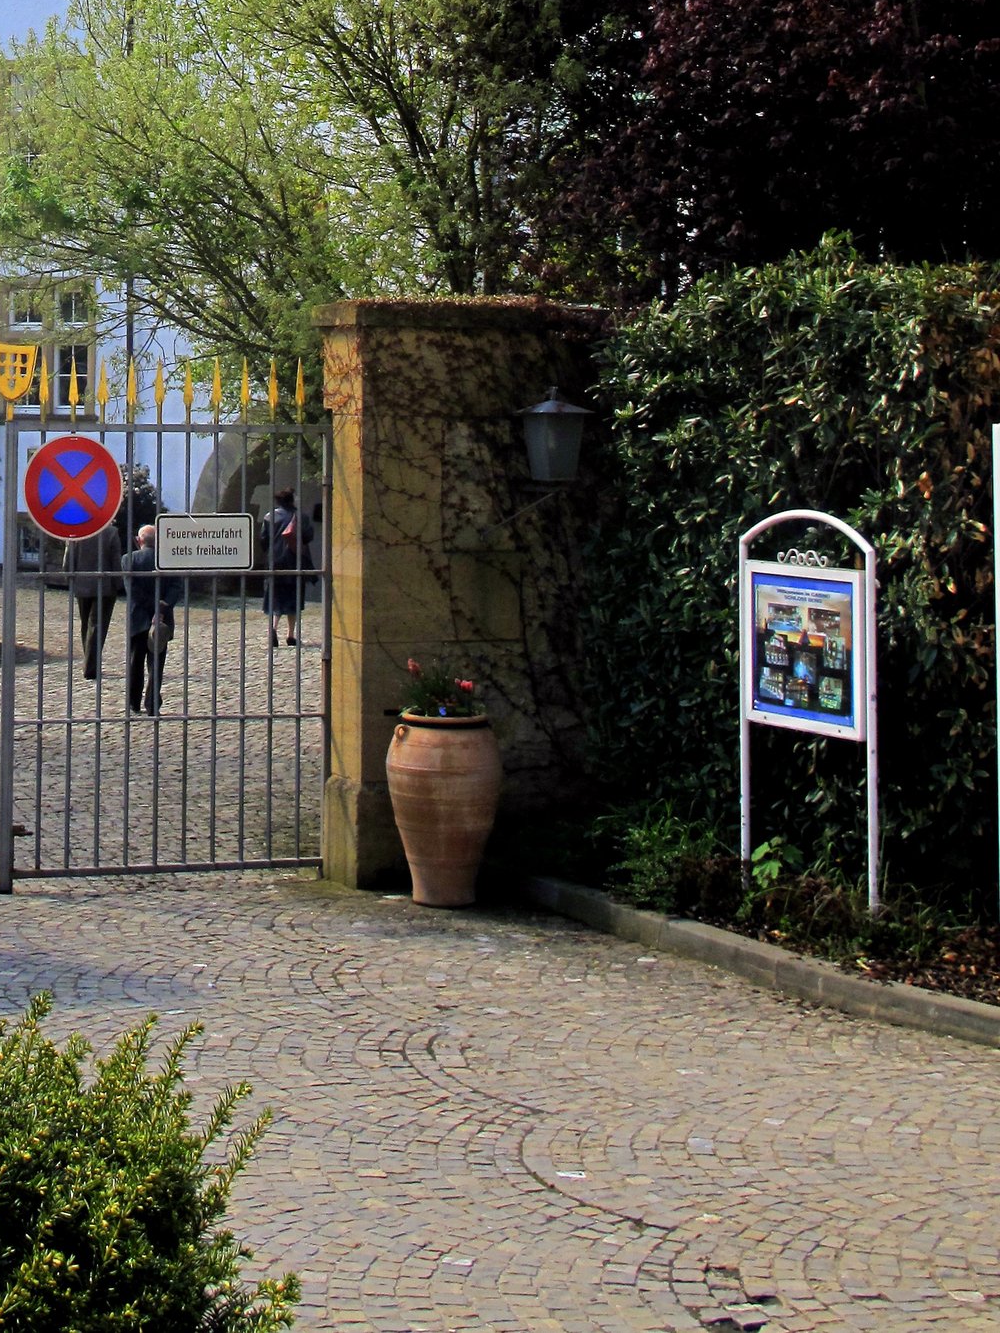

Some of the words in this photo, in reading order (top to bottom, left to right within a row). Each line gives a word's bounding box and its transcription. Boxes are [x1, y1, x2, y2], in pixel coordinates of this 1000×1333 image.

[166, 528, 242, 539] Feuerwehrzufahrt
[171, 545, 193, 556] stets
[196, 544, 238, 556] freihalten
